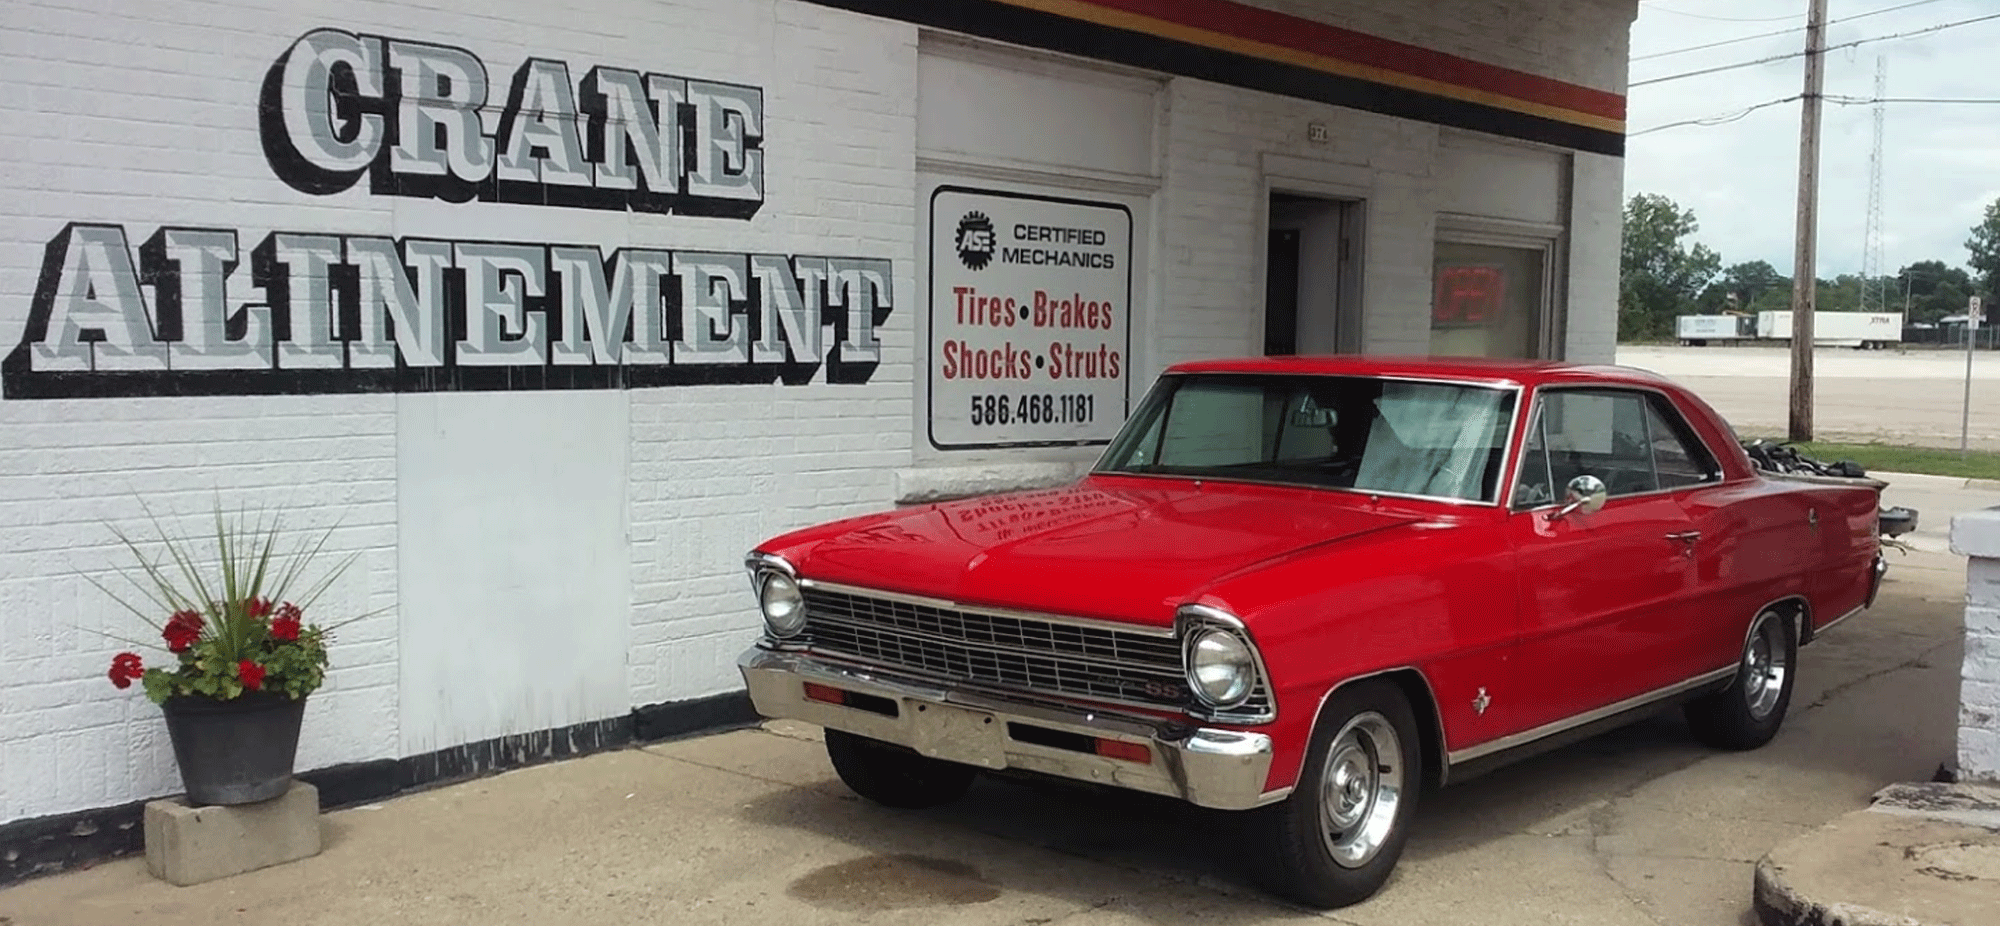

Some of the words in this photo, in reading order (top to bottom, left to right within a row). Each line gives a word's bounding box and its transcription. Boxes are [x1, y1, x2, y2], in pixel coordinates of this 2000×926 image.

[262, 28, 764, 214] CRANE
[960, 230, 990, 252] ASE
[1013, 224, 1106, 246] CERTIFIED
[1002, 248, 1115, 269] MECHANICS
[8, 223, 893, 390] ALINEMENT
[953, 287, 1016, 327] Tires
[1034, 290, 1112, 330] Brakes
[943, 340, 1032, 379] Shocks
[1048, 342, 1120, 379] Struts
[971, 394, 1094, 425] 586.468.1181
[1145, 681, 1180, 699] SS
